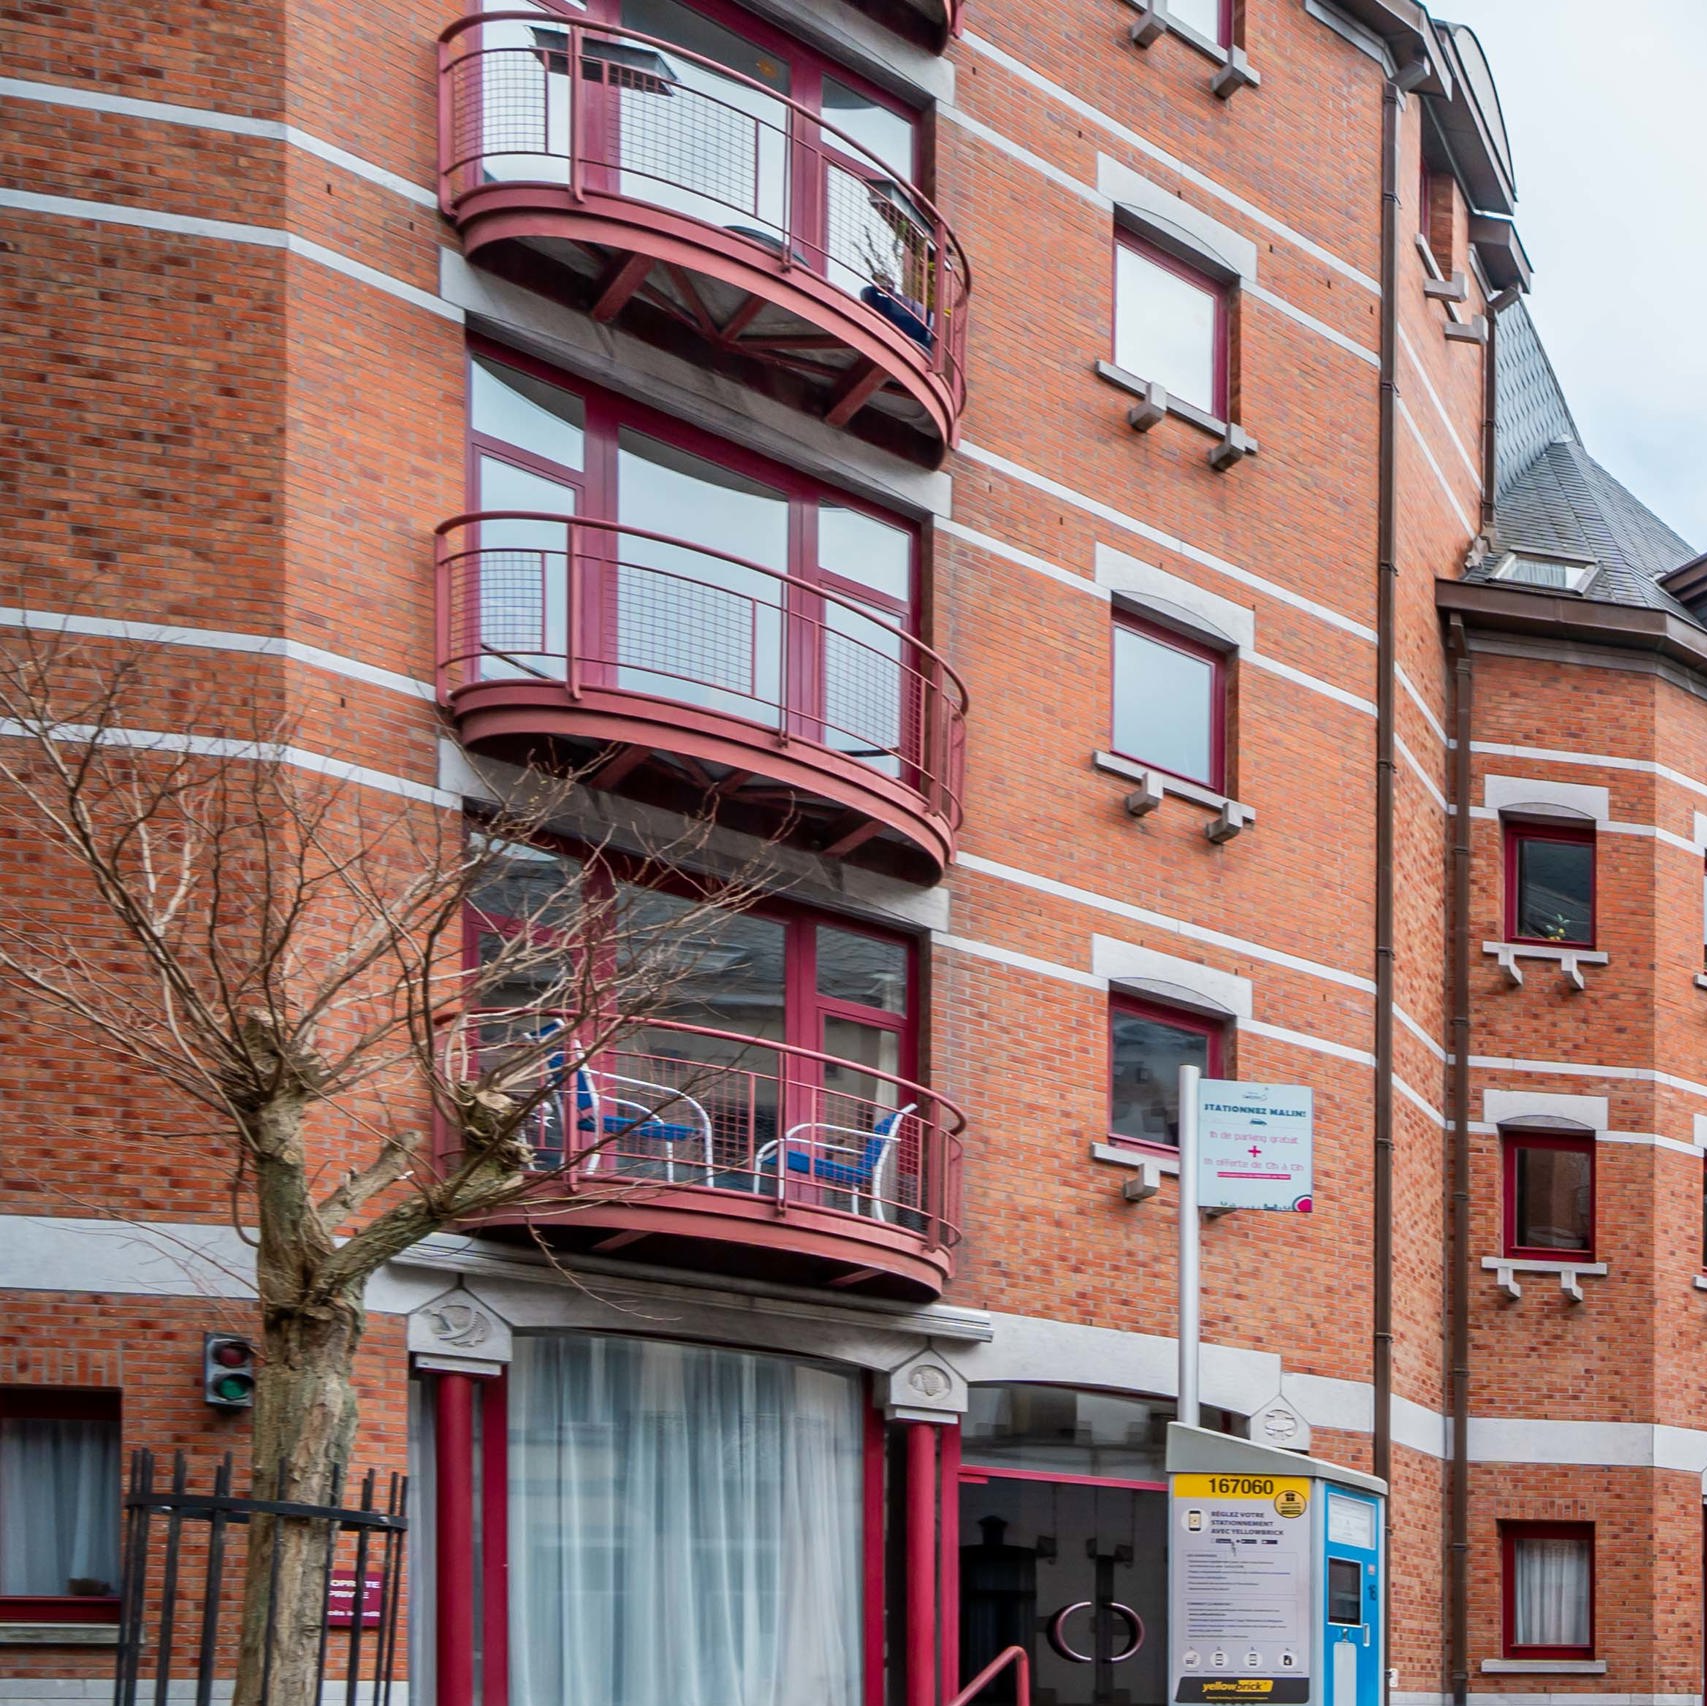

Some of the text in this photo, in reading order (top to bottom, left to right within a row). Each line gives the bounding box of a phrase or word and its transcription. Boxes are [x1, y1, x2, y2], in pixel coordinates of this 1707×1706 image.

[1204, 1103, 1307, 1118] STATIONNEZ MALIN!
[1234, 1133, 1267, 1143] parking
[1208, 1478, 1274, 1495] 167060
[1240, 1511, 1265, 1519] VOTRE
[1210, 1519, 1274, 1527] STATIONNEMENT
[1210, 1527, 1284, 1536] AVEC YELLOWBRICK
[1202, 1680, 1263, 1693] yellowbrick
